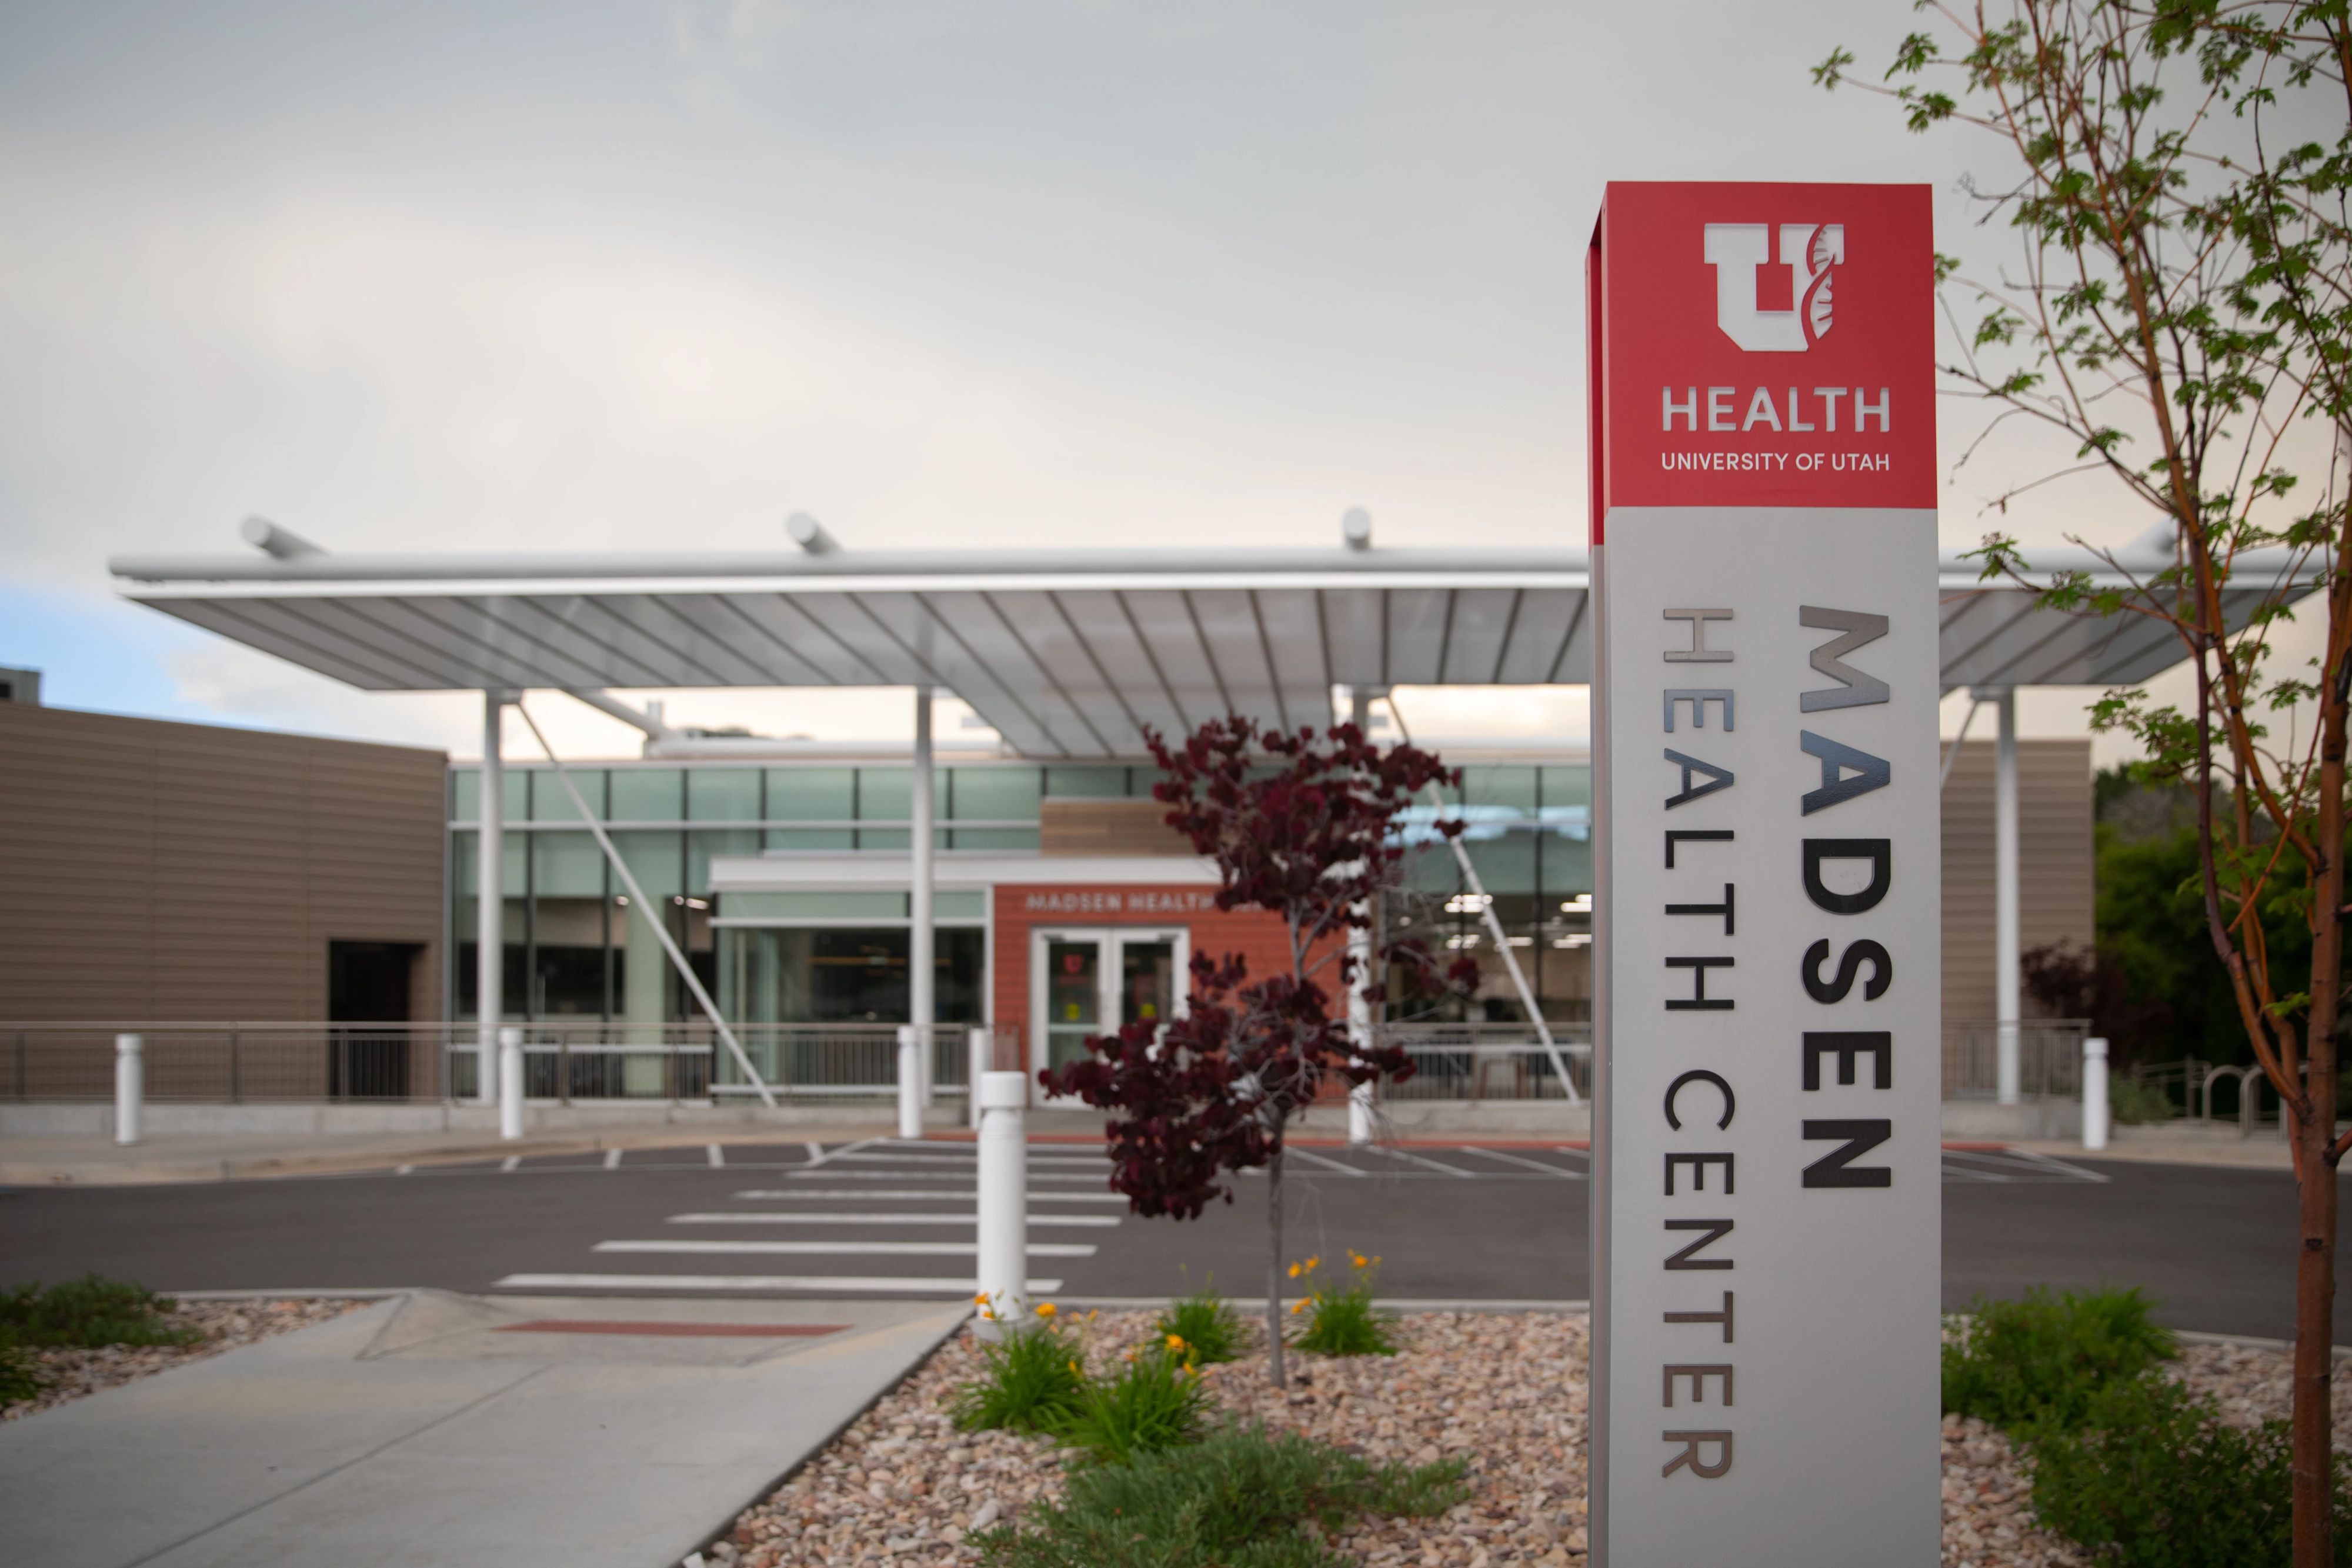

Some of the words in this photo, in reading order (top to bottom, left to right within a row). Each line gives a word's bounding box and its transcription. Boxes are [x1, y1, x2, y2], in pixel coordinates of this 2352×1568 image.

[1662, 386, 1890, 433] HEALTH
[1662, 452, 1789, 471] UNIVERSITY
[1796, 453, 1824, 471] OF
[1831, 453, 1890, 471] UTAH
[1025, 892, 1122, 913] MADSEN
[1663, 608, 1735, 1011] HEALTH
[1799, 605, 1892, 1188] MADSEN
[1662, 1069, 1736, 1478] CENTER
